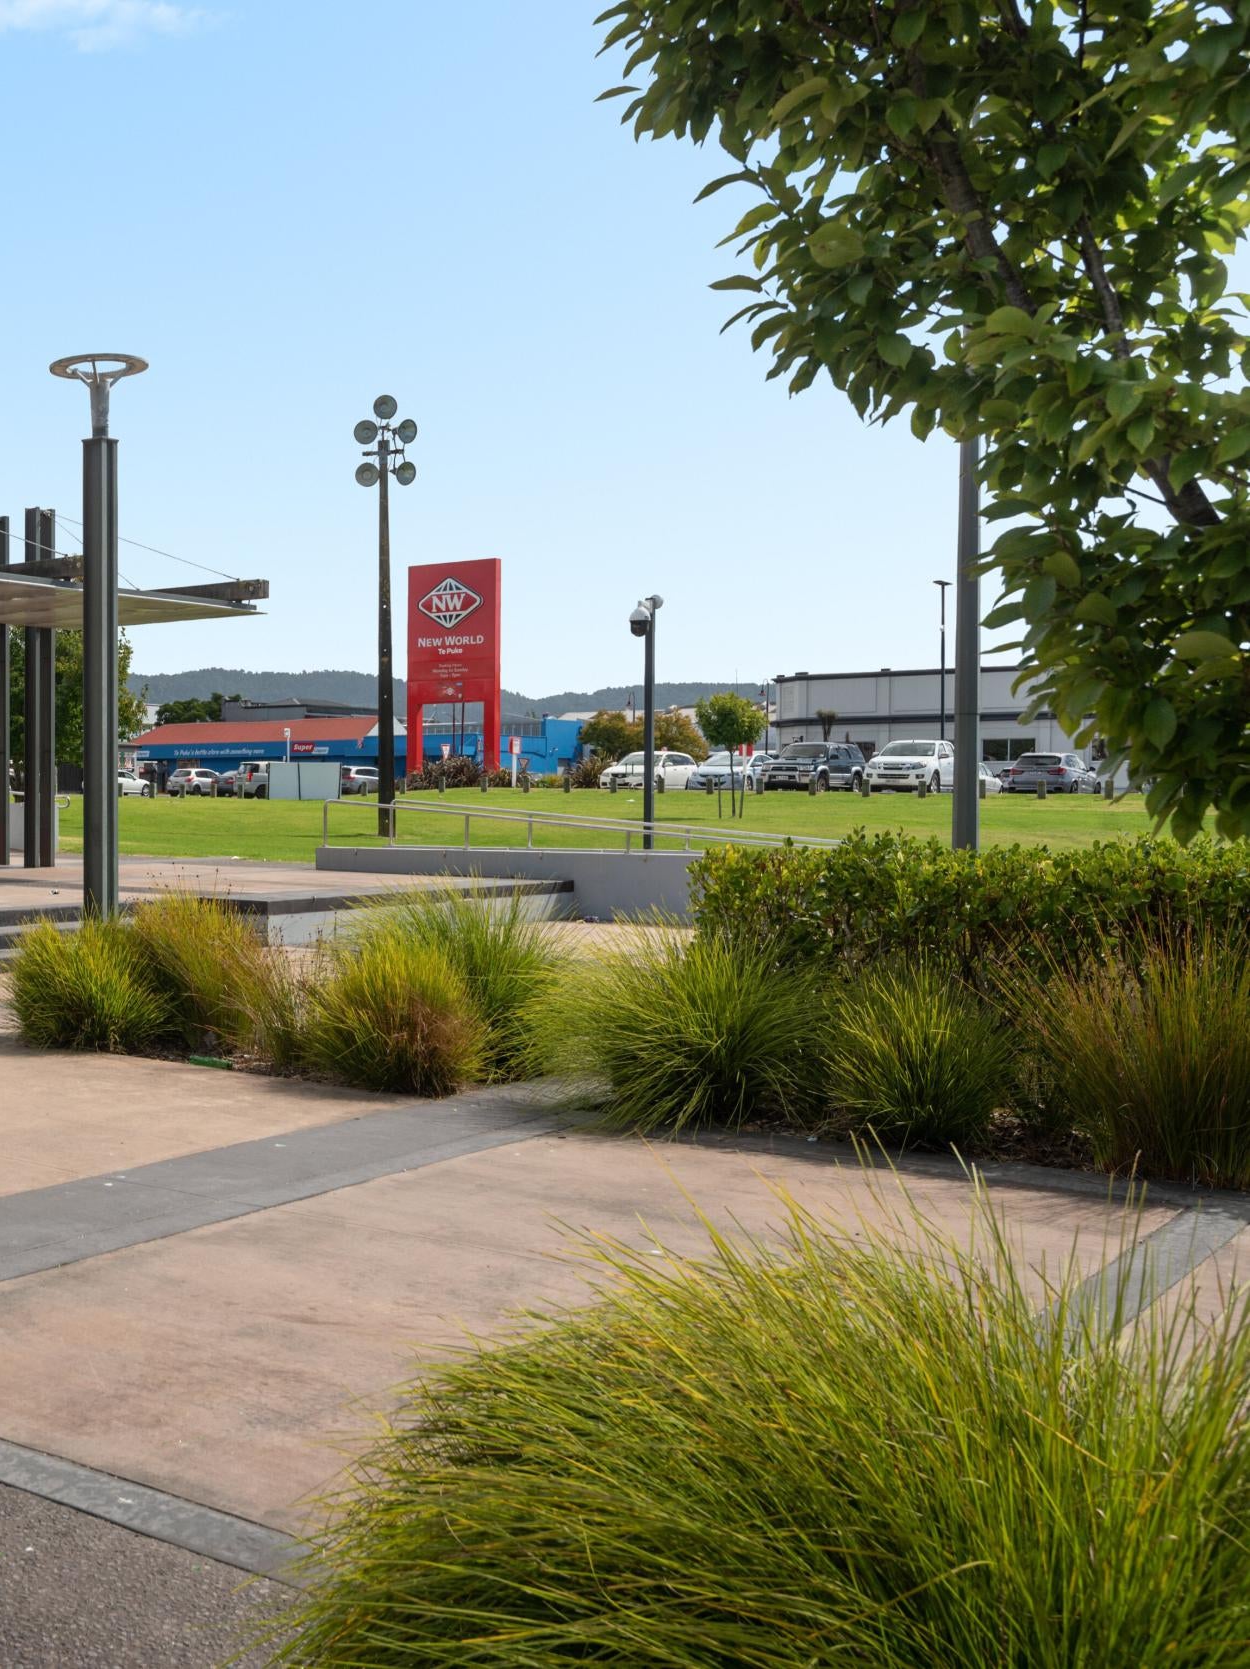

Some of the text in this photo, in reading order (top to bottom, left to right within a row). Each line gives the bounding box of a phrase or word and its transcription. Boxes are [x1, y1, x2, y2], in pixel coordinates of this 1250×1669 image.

[431, 594, 466, 612] NW
[418, 635, 484, 648] NEW WORLD
[293, 743, 313, 751] Super
